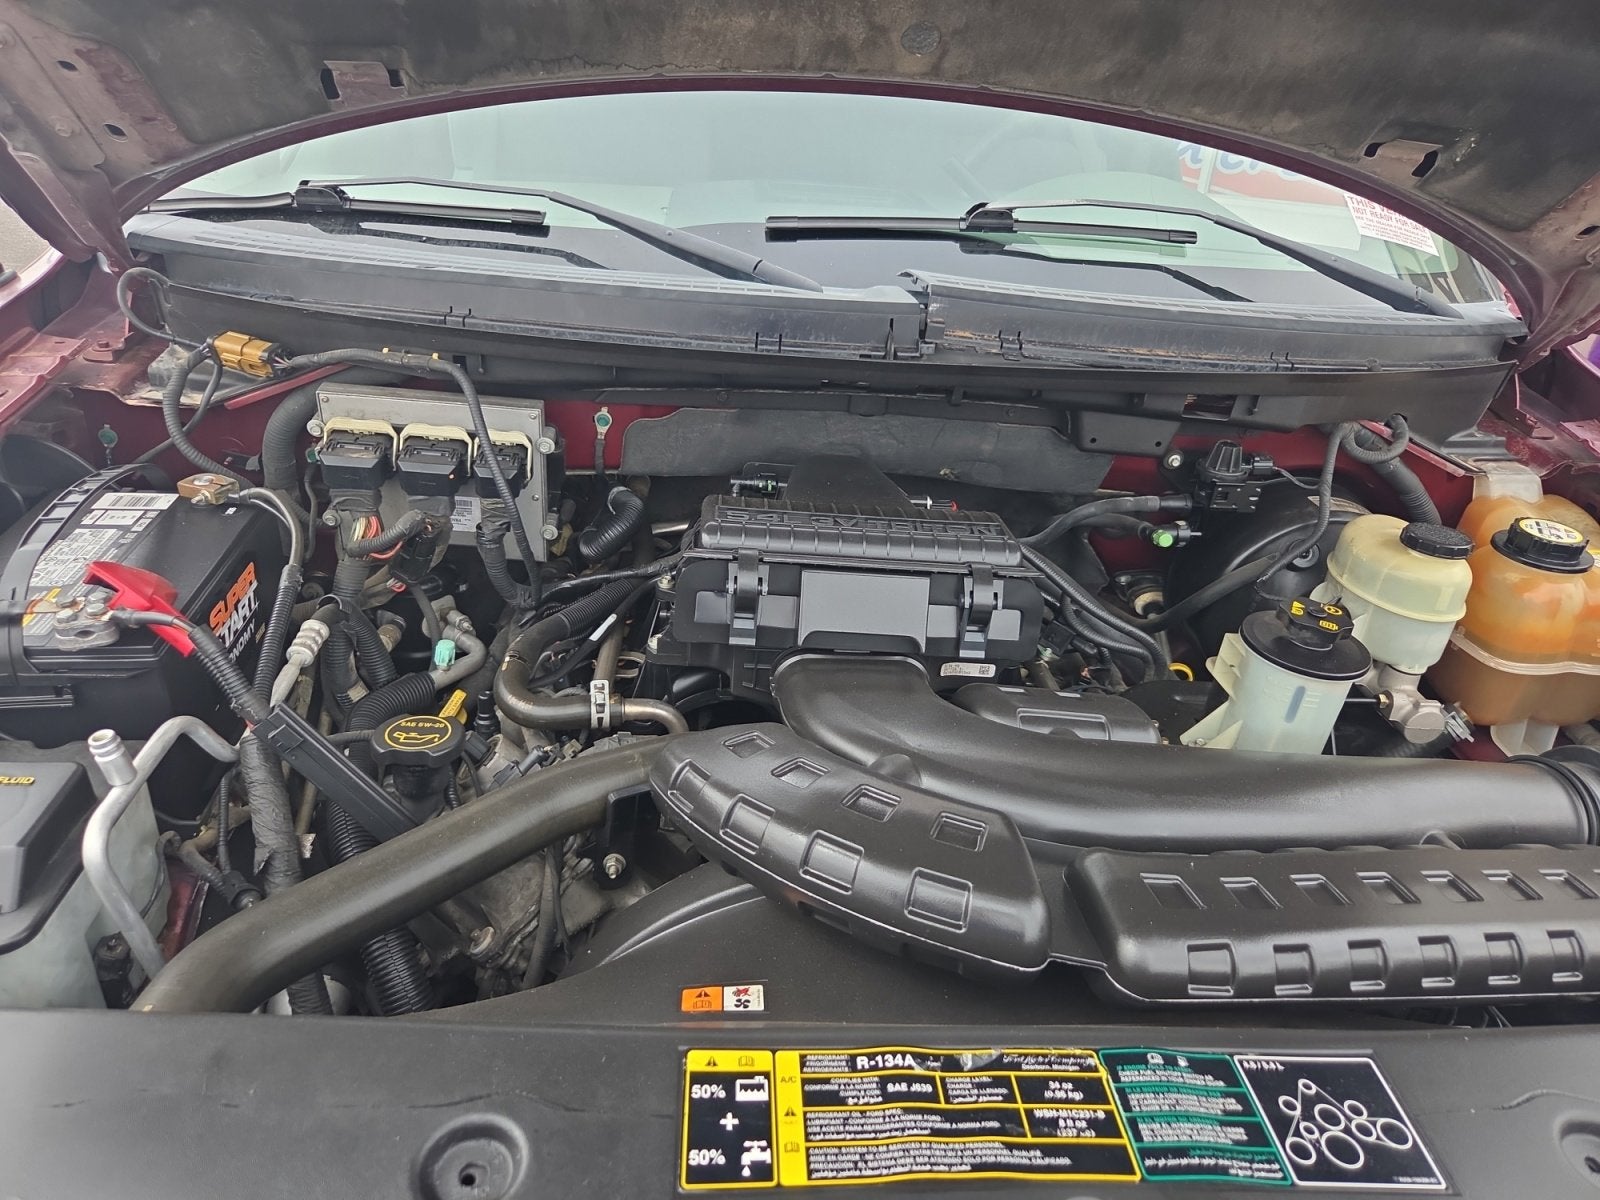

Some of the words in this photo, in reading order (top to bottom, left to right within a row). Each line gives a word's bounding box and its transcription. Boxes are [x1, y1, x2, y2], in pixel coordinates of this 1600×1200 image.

[1347, 196, 1376, 210] THIS
[1352, 206, 1368, 216] NOT
[209, 562, 257, 635] SUPER
[217, 579, 260, 648] TART
[856, 1053, 917, 1070] R-134A
[780, 1075, 797, 1084] A/C
[886, 1082, 908, 1093] SAE
[910, 1082, 933, 1093] J639
[690, 1083, 727, 1099] 50%
[688, 1148, 726, 1166] 50%
